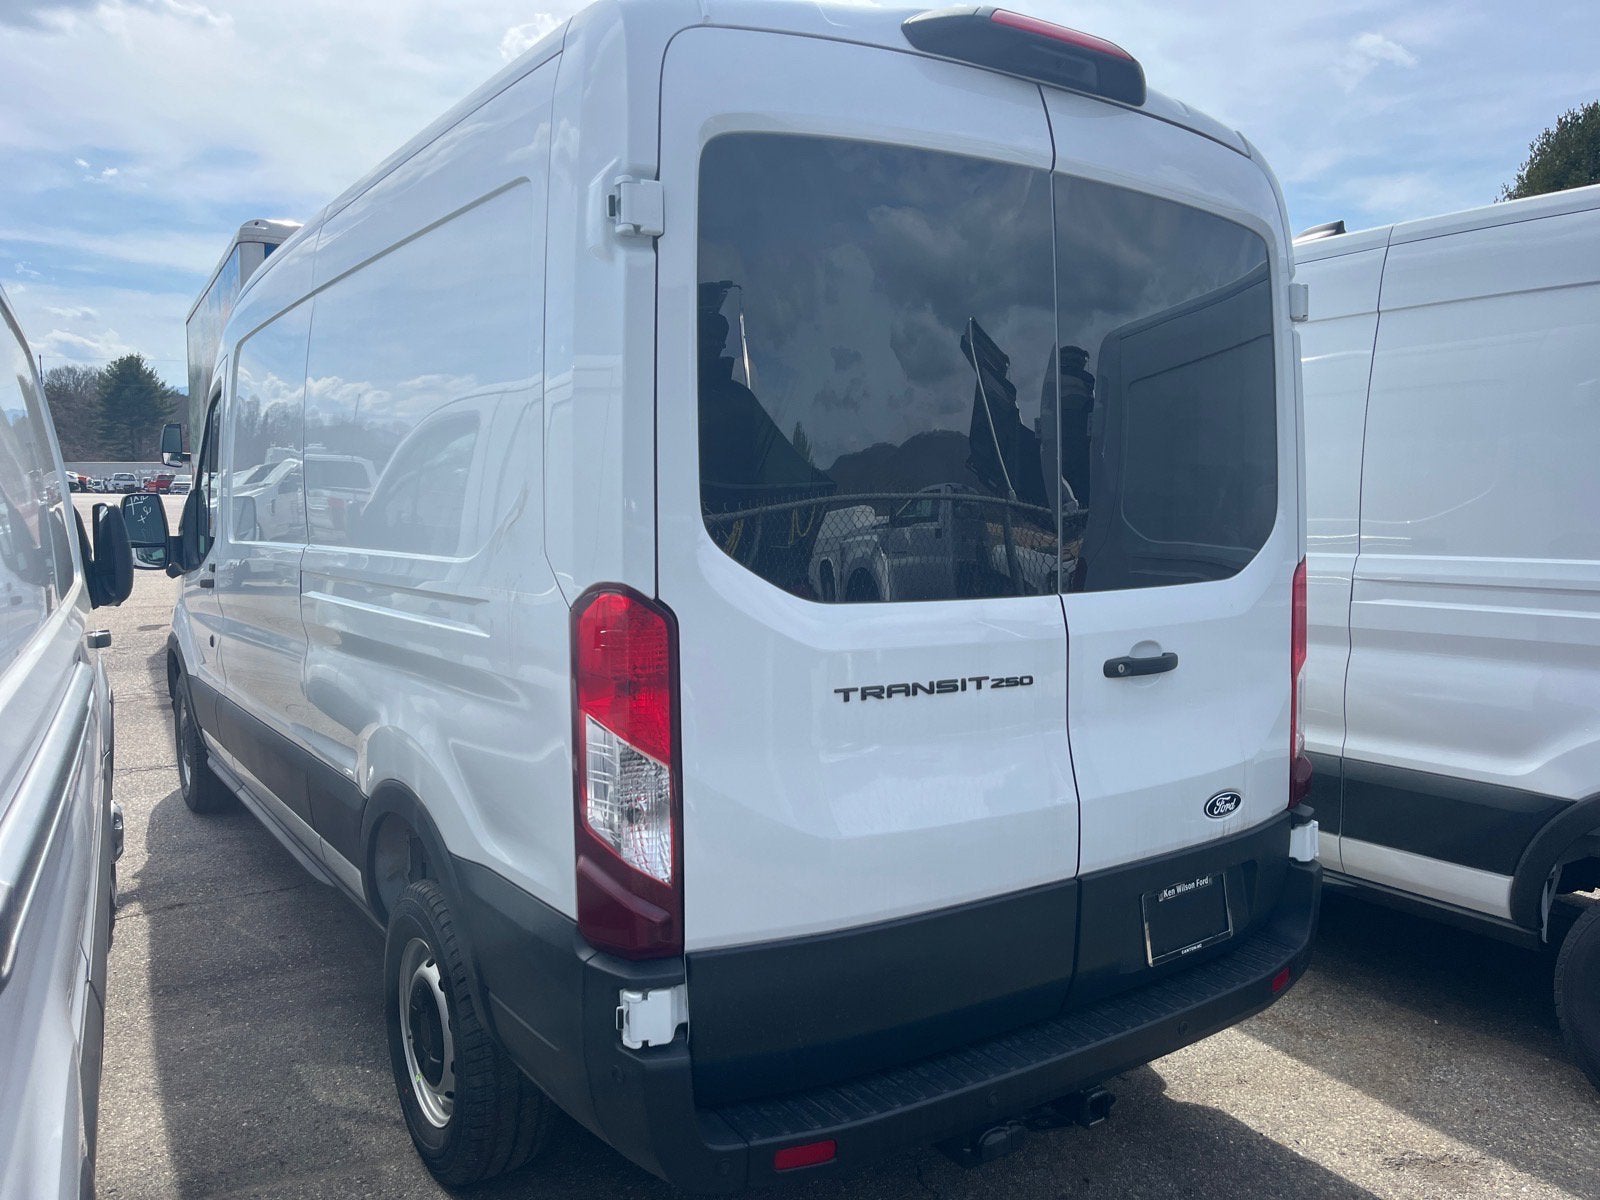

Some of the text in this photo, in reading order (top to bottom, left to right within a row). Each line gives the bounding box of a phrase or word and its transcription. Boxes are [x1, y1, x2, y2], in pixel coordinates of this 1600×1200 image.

[834, 675, 1033, 702] TRANSIT 250
[1213, 796, 1236, 814] Ford
[1163, 876, 1209, 898] Ken Wilson Ford
